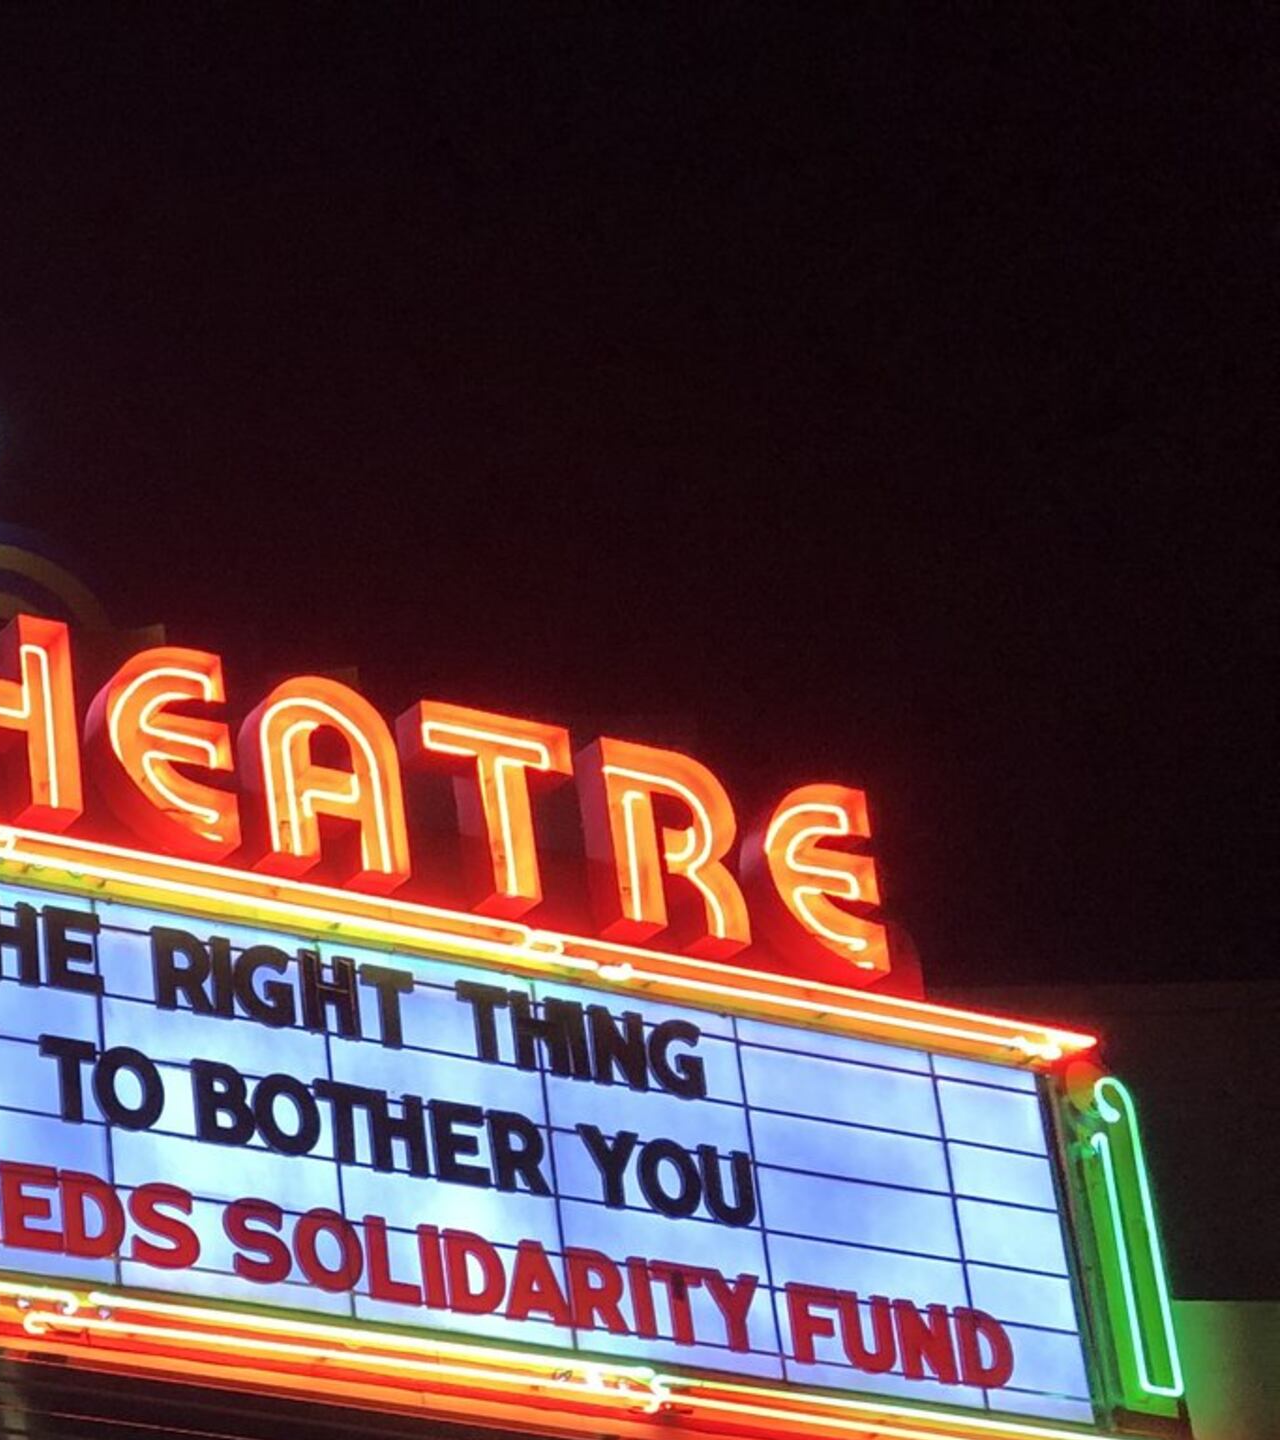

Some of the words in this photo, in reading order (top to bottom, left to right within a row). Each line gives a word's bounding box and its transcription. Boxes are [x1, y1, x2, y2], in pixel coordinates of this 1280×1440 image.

[153, 930, 413, 1050] RIGHT
[455, 982, 707, 1099] THING
[40, 1034, 164, 1131] TO
[195, 1059, 551, 1196] BOTHER
[579, 1130, 759, 1230] YOU
[233, 1200, 762, 1348] SOLIDARITY
[786, 1284, 1012, 1390] FUND
